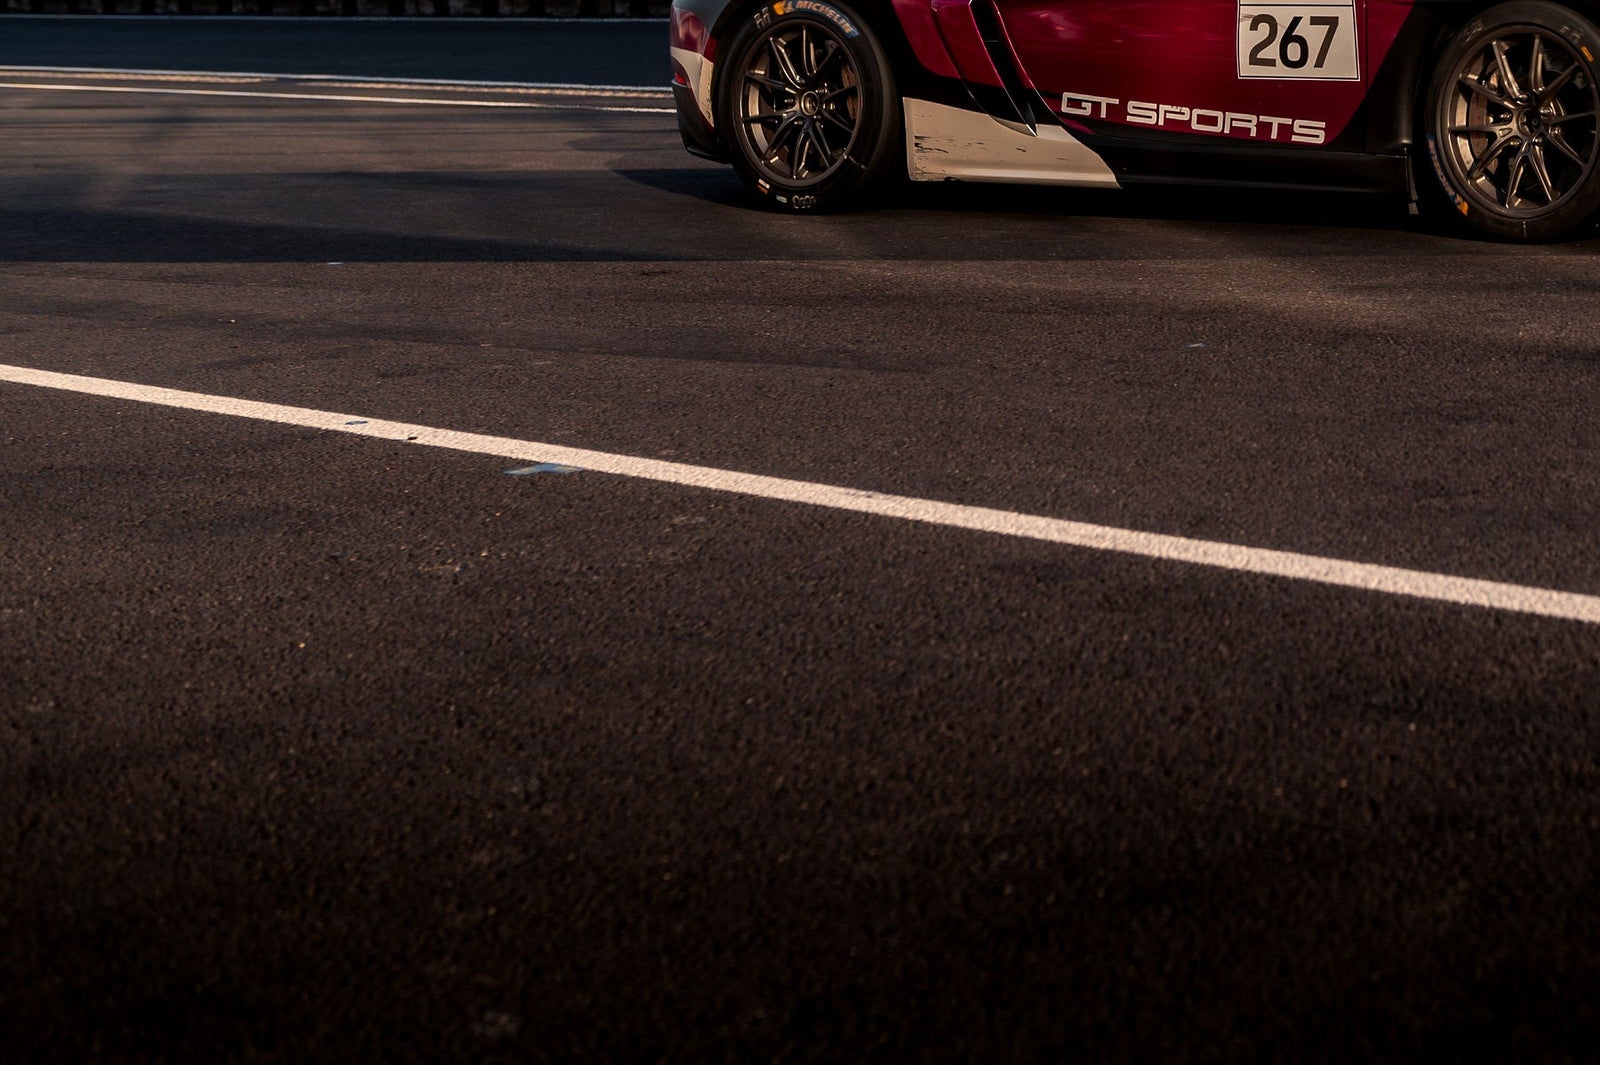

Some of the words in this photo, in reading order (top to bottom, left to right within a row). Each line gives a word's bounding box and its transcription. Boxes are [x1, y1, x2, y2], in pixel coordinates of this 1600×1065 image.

[796, 0, 854, 34] MICHELIN
[1248, 14, 1340, 69] 267
[1061, 92, 1119, 118] GT
[1126, 100, 1326, 144] SPORTS
